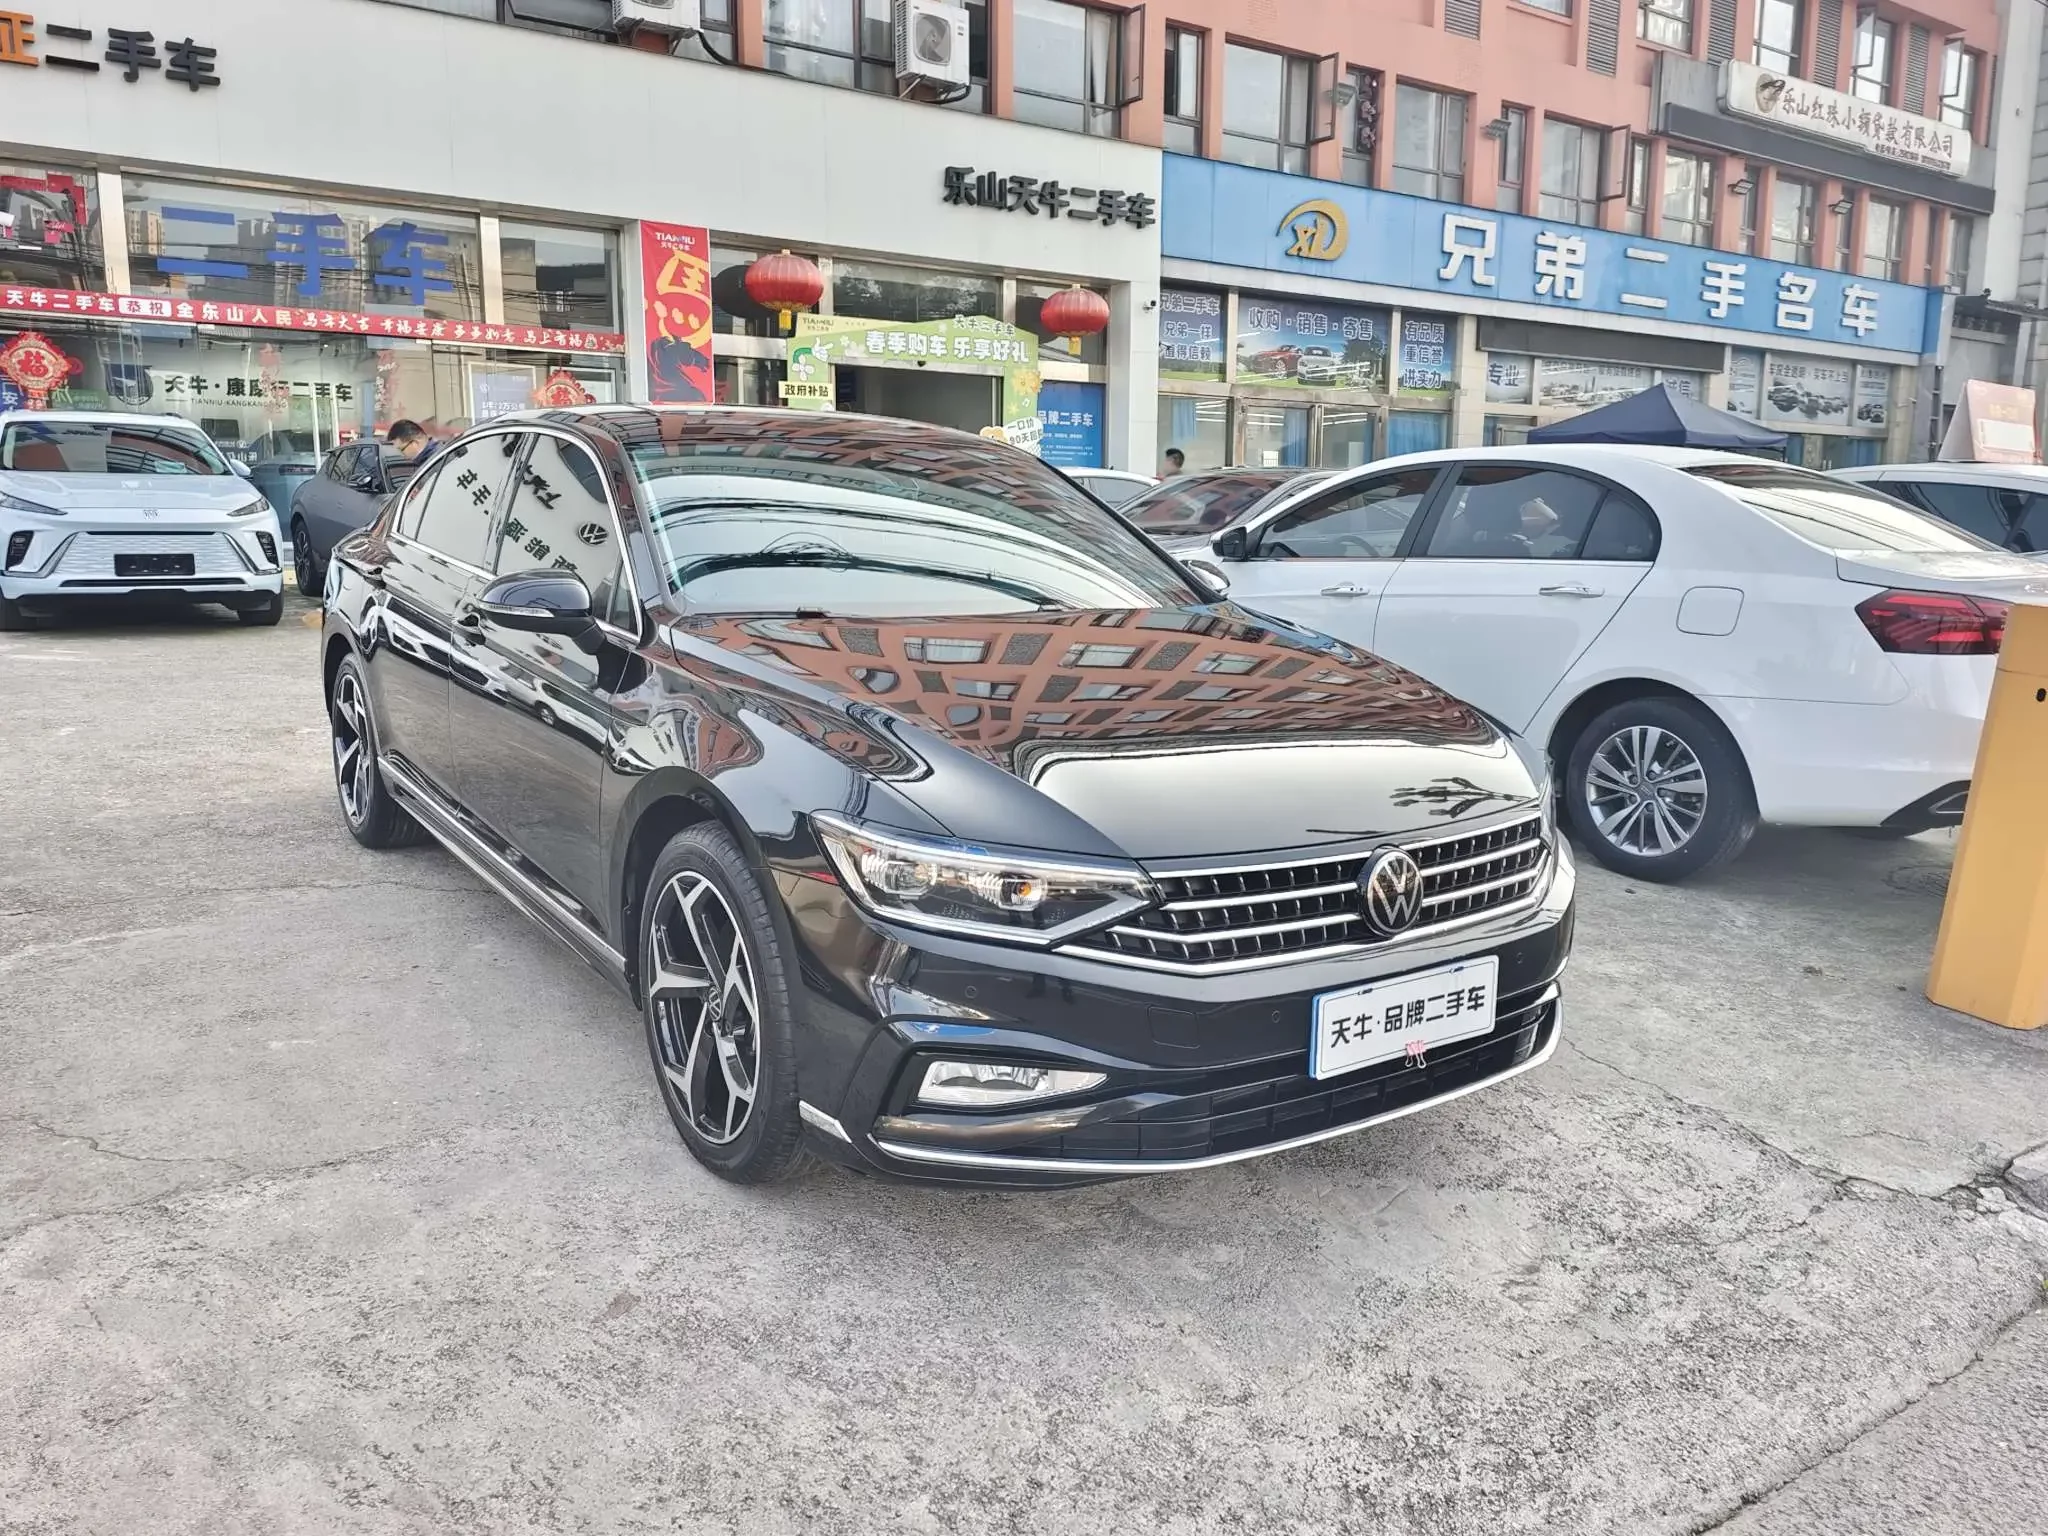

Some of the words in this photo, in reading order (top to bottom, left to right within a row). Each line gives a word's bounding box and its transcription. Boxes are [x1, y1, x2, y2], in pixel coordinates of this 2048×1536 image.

[943, 166, 1156, 229] 乐山天牛二手车
[156, 205, 455, 306] 二手车
[1438, 212, 1881, 338] 兄弟二手名车
[6, 289, 116, 313] 天牛二手车
[126, 300, 164, 315] 恭祝
[954, 313, 1016, 337] 天牛二手车
[1405, 321, 1446, 344] 有品质
[865, 330, 948, 358] 春季购车
[953, 336, 1030, 363] 乐享好礼
[1405, 344, 1444, 366] 重信誉
[784, 383, 829, 397] 政府补贴
[1402, 367, 1443, 389] 讲实力
[1037, 410, 1093, 427] 品牌二手车
[1330, 985, 1486, 1048] 天牛·品牌二手车
